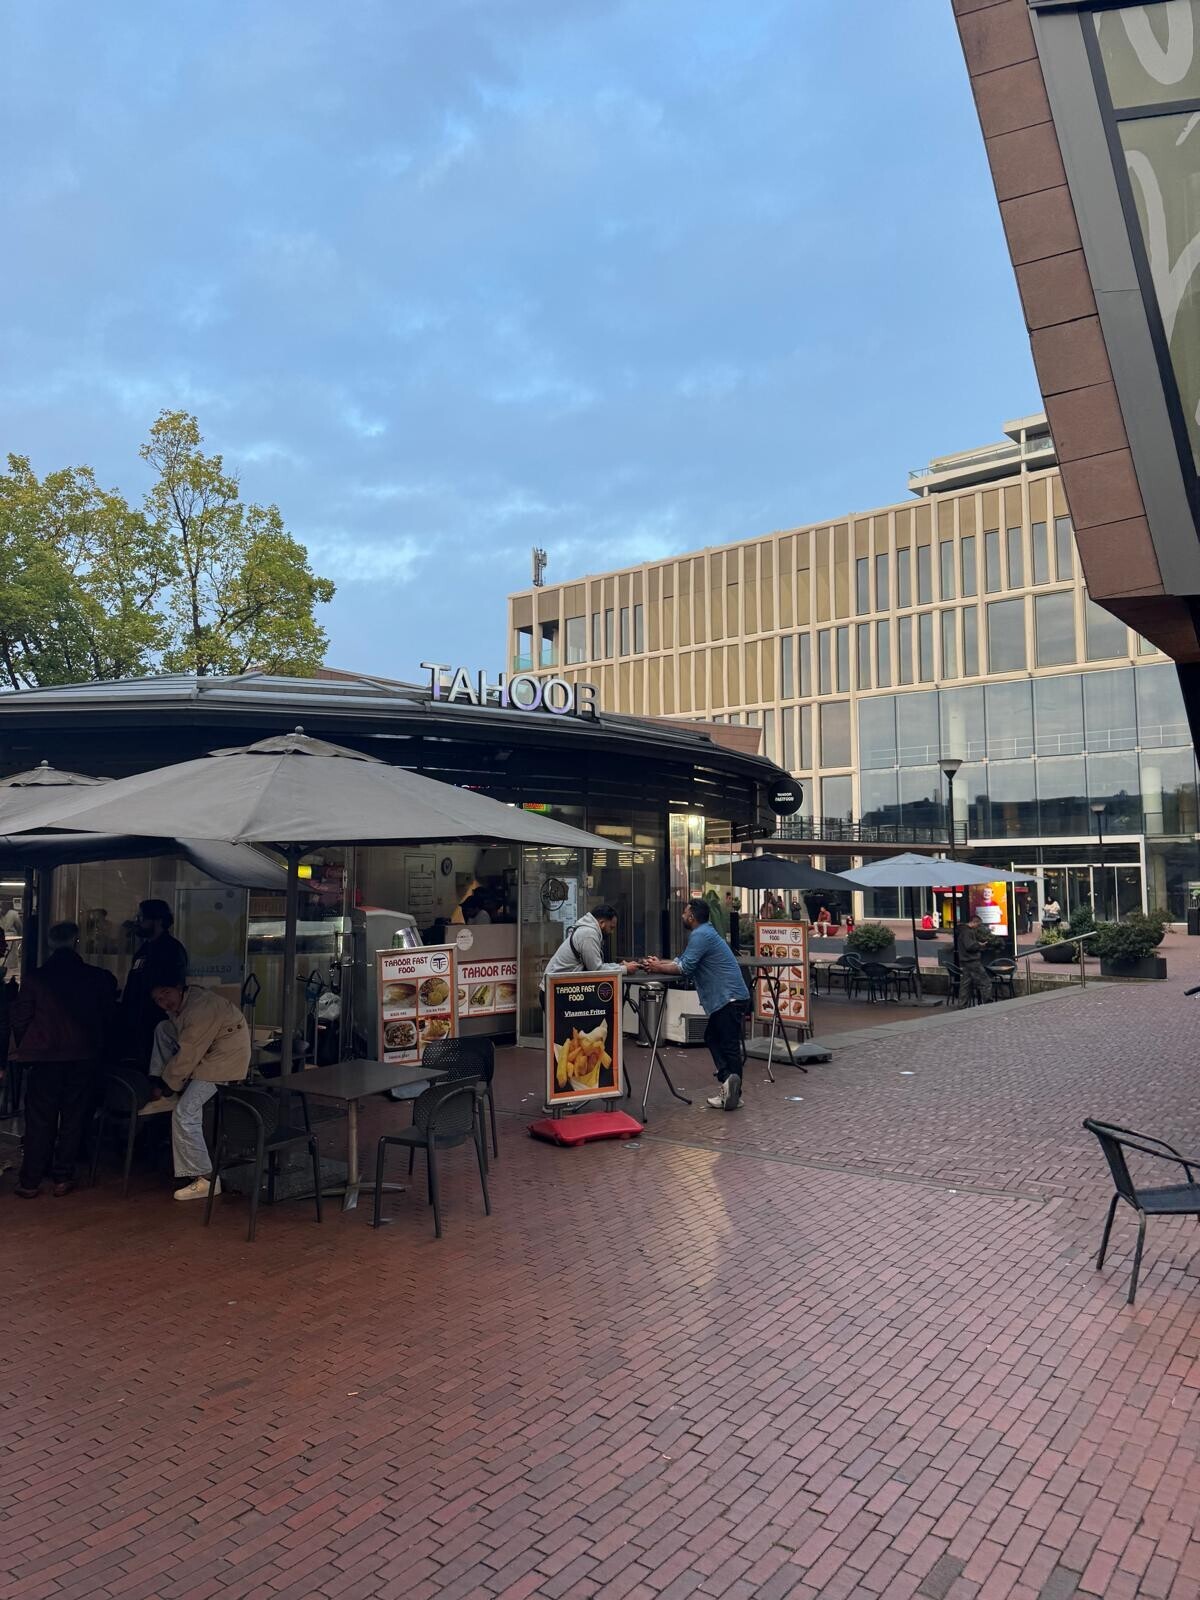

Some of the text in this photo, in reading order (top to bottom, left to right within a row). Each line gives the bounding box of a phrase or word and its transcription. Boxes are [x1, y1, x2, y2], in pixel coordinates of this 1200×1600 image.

[420, 662, 602, 721] TAHOOR
[384, 956, 428, 967] TAHOOR FAST
[398, 966, 416, 974] FOOD
[462, 964, 517, 978] TAHOOR FAS
[555, 985, 581, 994] TAHOOR
[581, 984, 596, 993] FAST
[568, 993, 585, 1001] FOOD
